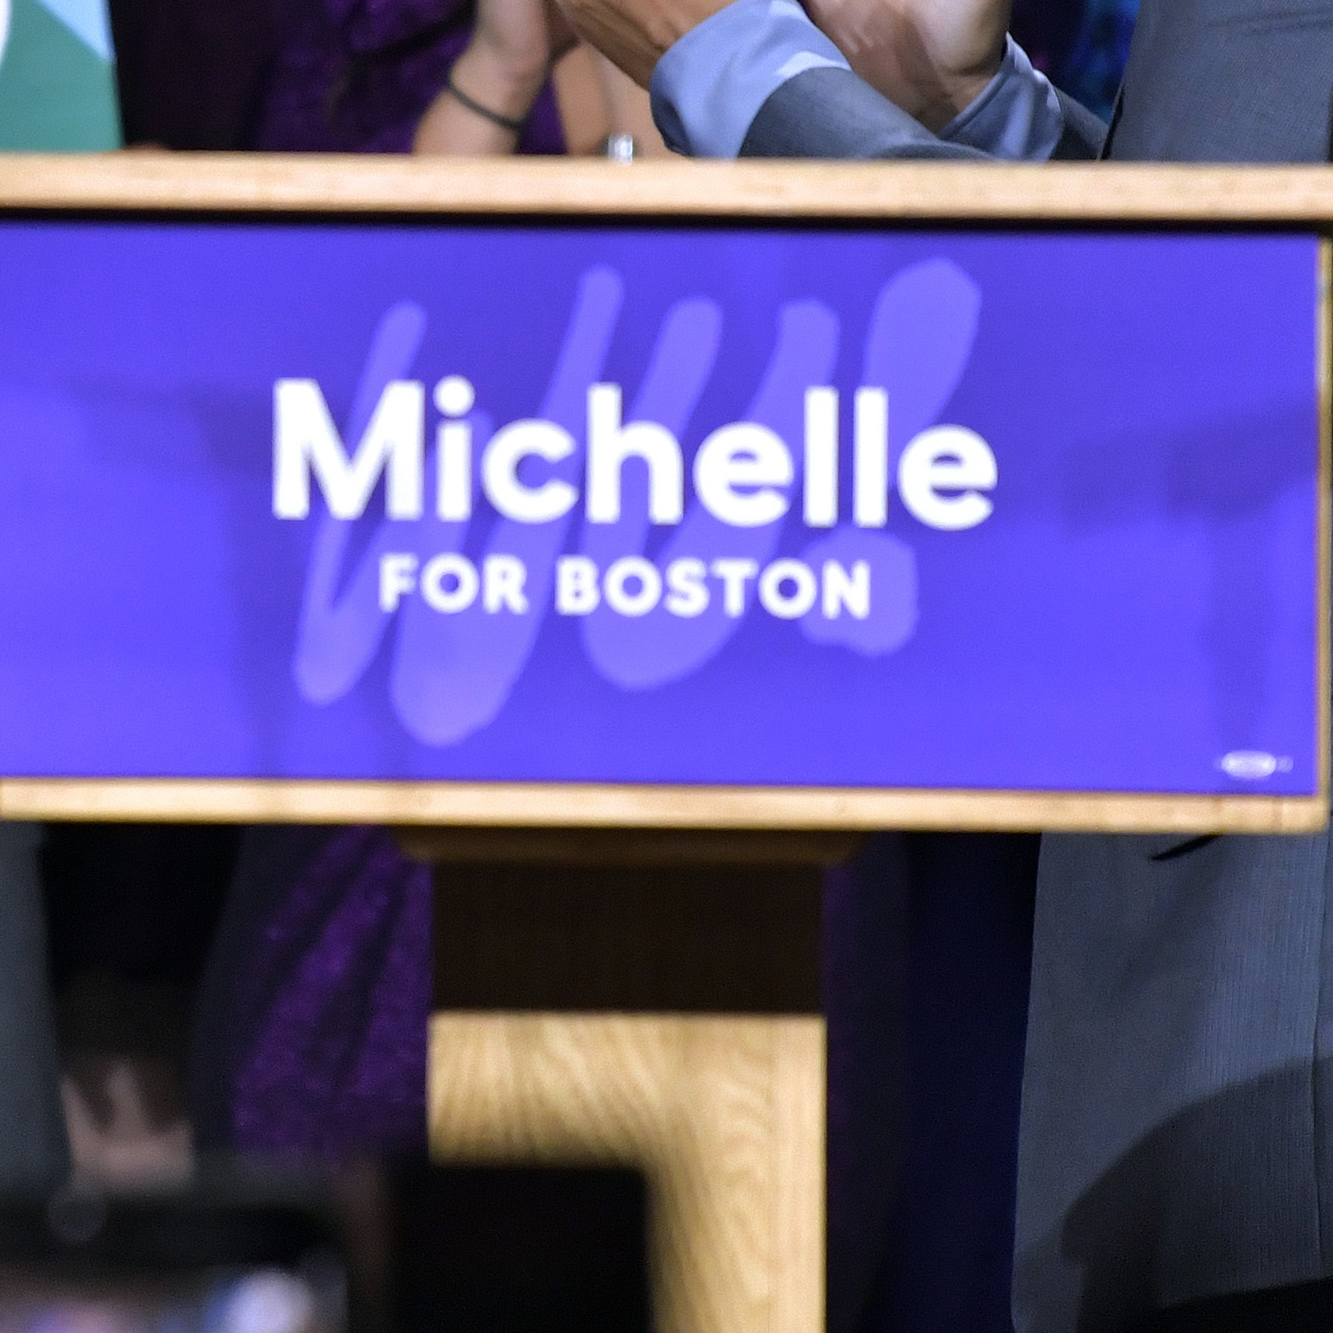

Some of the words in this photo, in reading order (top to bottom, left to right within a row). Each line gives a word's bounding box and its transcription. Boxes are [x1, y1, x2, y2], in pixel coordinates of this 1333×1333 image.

[271, 374, 999, 532] Michelle
[379, 552, 529, 615] FOR
[554, 554, 871, 621] BOSTON
